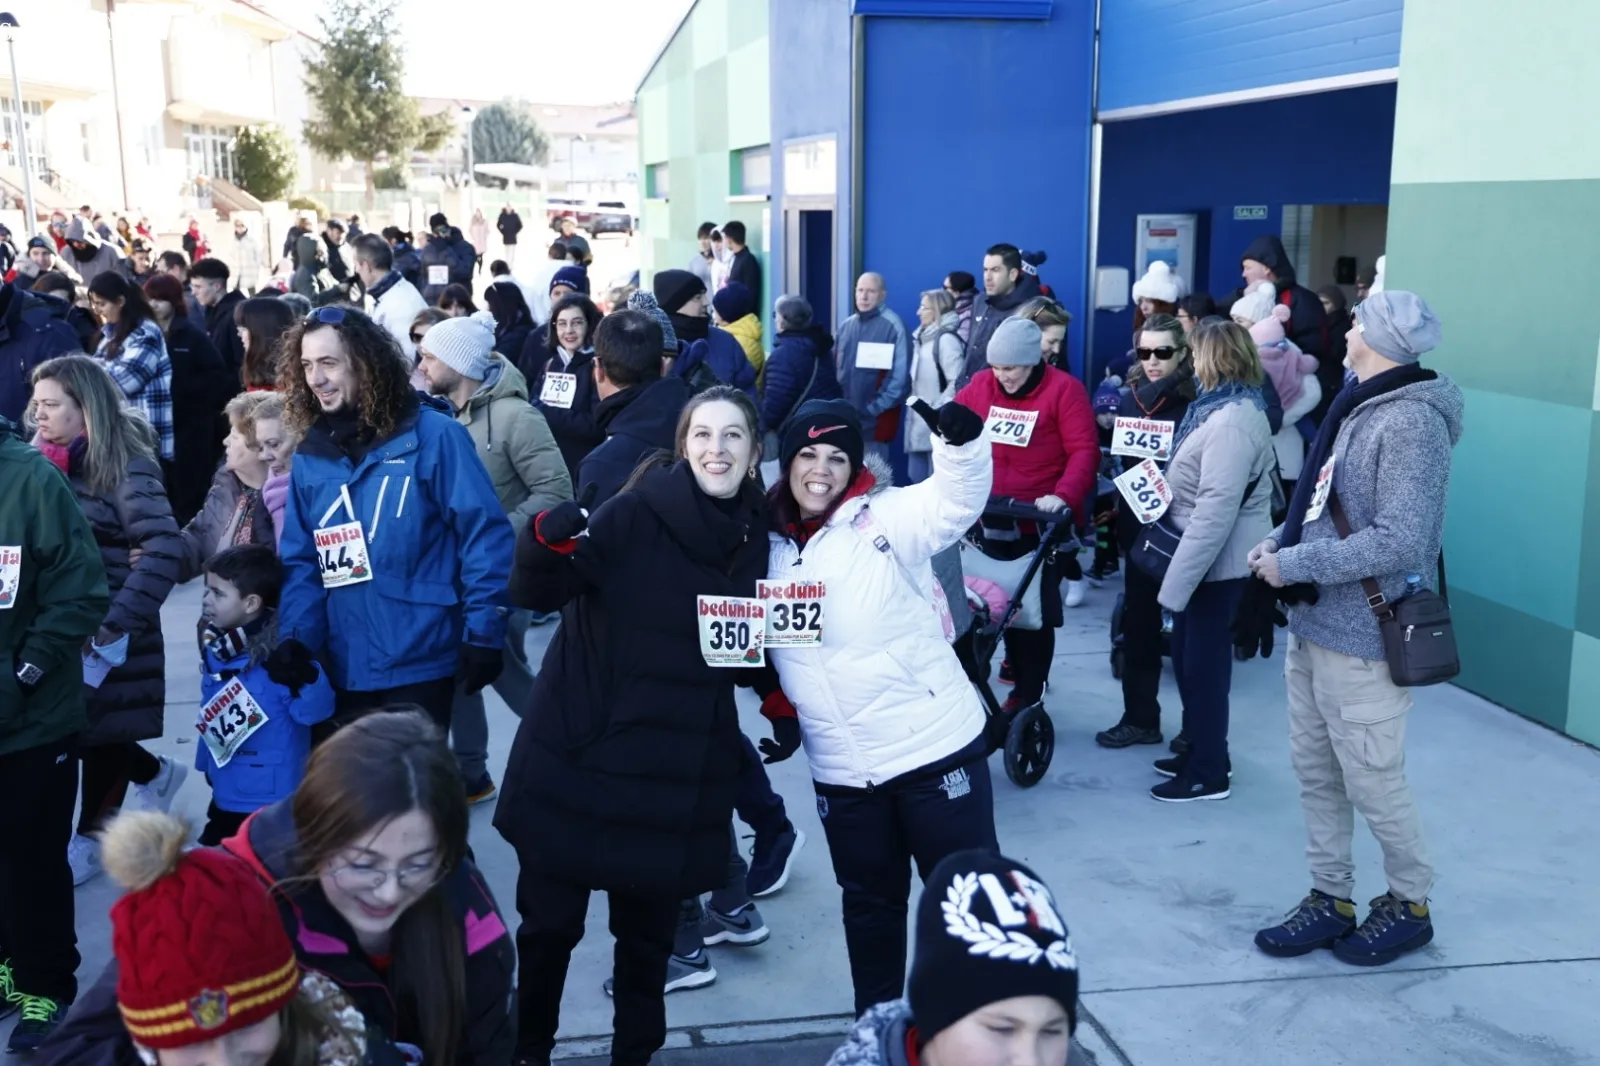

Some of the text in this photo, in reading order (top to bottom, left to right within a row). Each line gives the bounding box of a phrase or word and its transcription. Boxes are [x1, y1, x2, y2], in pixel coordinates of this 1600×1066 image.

[549, 380, 570, 392] 730
[991, 421, 1026, 437] 470
[1116, 419, 1172, 433] bedunia
[1123, 431, 1162, 450] 345
[1130, 476, 1162, 511] 369
[758, 581, 826, 600] beduni
[699, 598, 764, 618] bedunia
[772, 602, 821, 631] 352
[709, 620, 750, 651] 350
